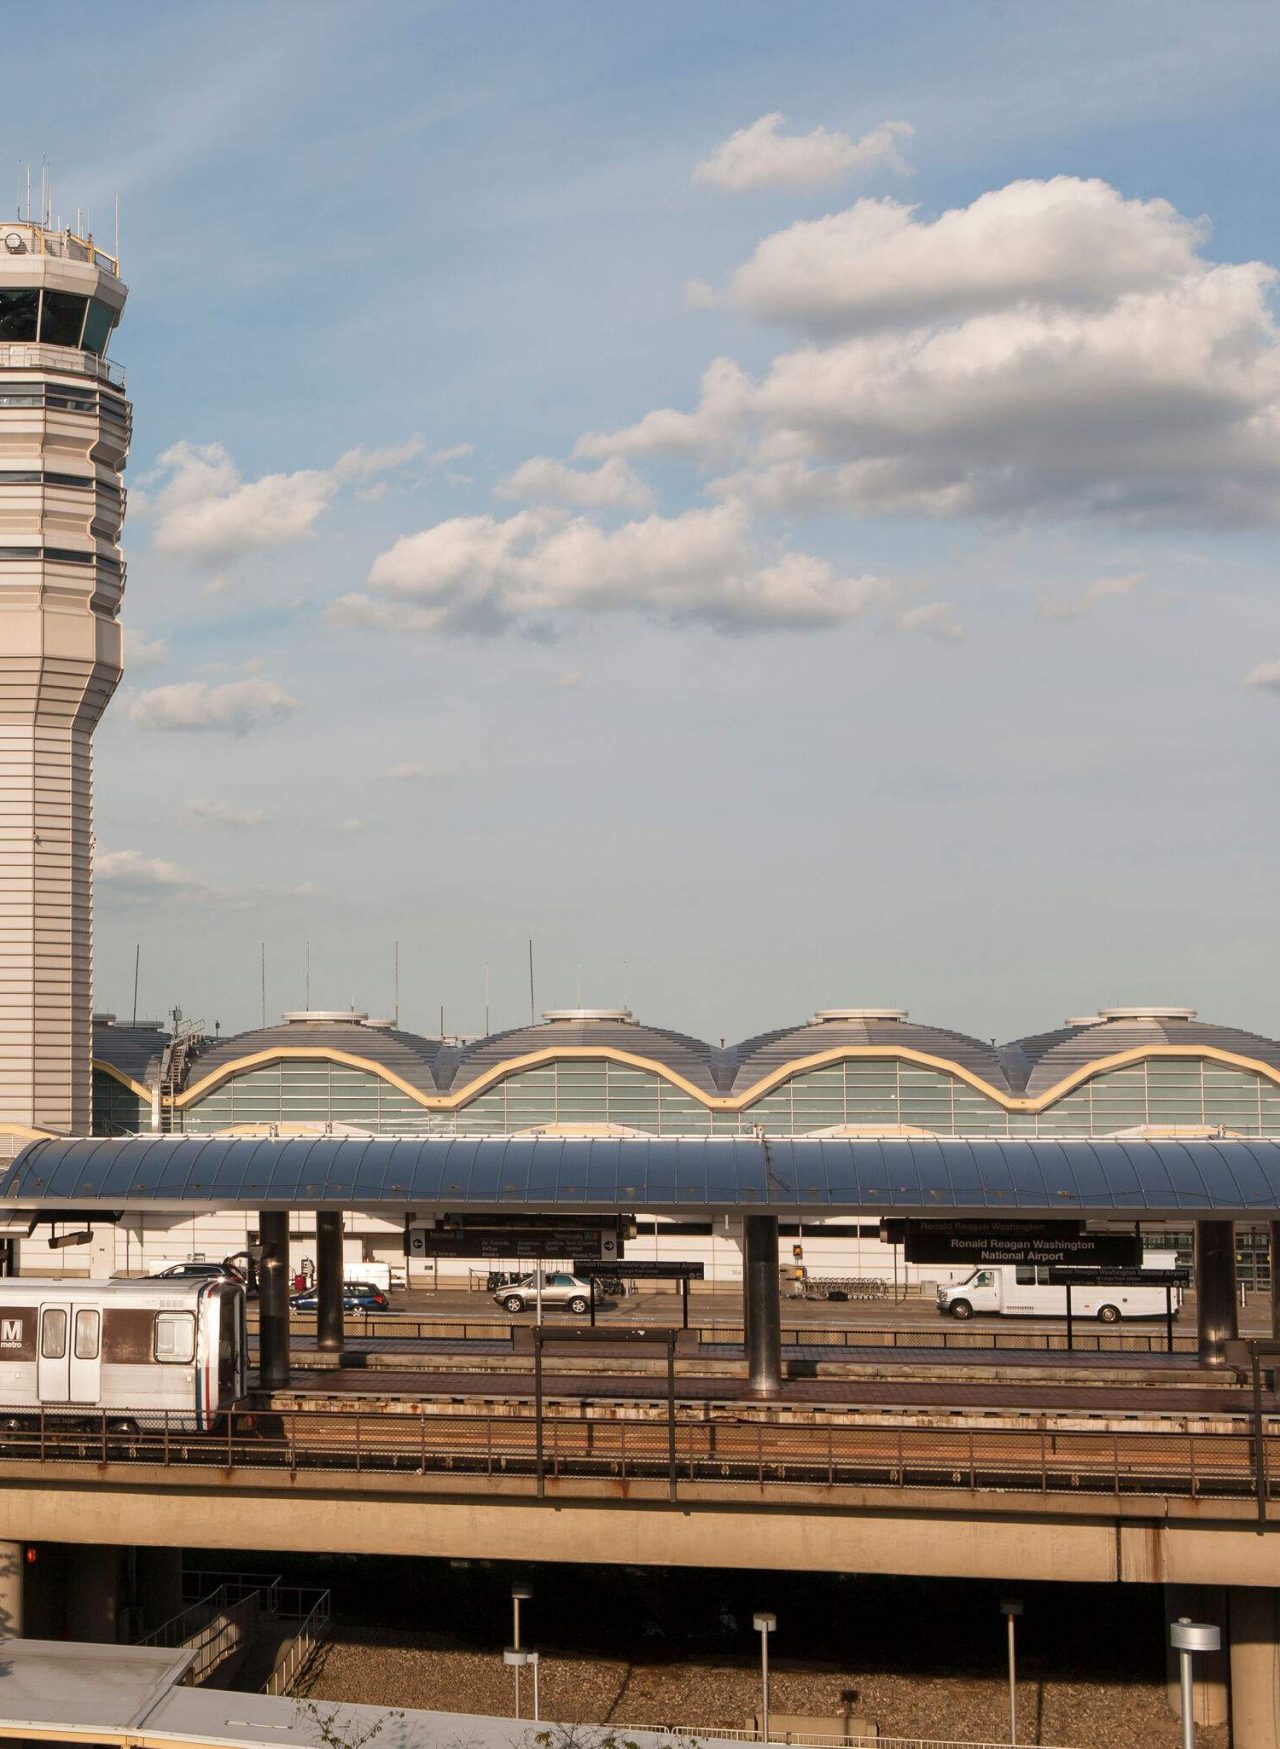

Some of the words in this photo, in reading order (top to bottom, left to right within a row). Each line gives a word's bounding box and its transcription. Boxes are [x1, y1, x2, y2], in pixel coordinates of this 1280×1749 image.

[992, 1223, 1045, 1233] Washington
[951, 1239, 987, 1249] Ronald
[990, 1239, 1030, 1251] Reagan
[1033, 1240, 1095, 1252] Washington
[981, 1250, 1024, 1261] National
[1028, 1251, 1064, 1262] Airport
[2, 1320, 22, 1341] M
